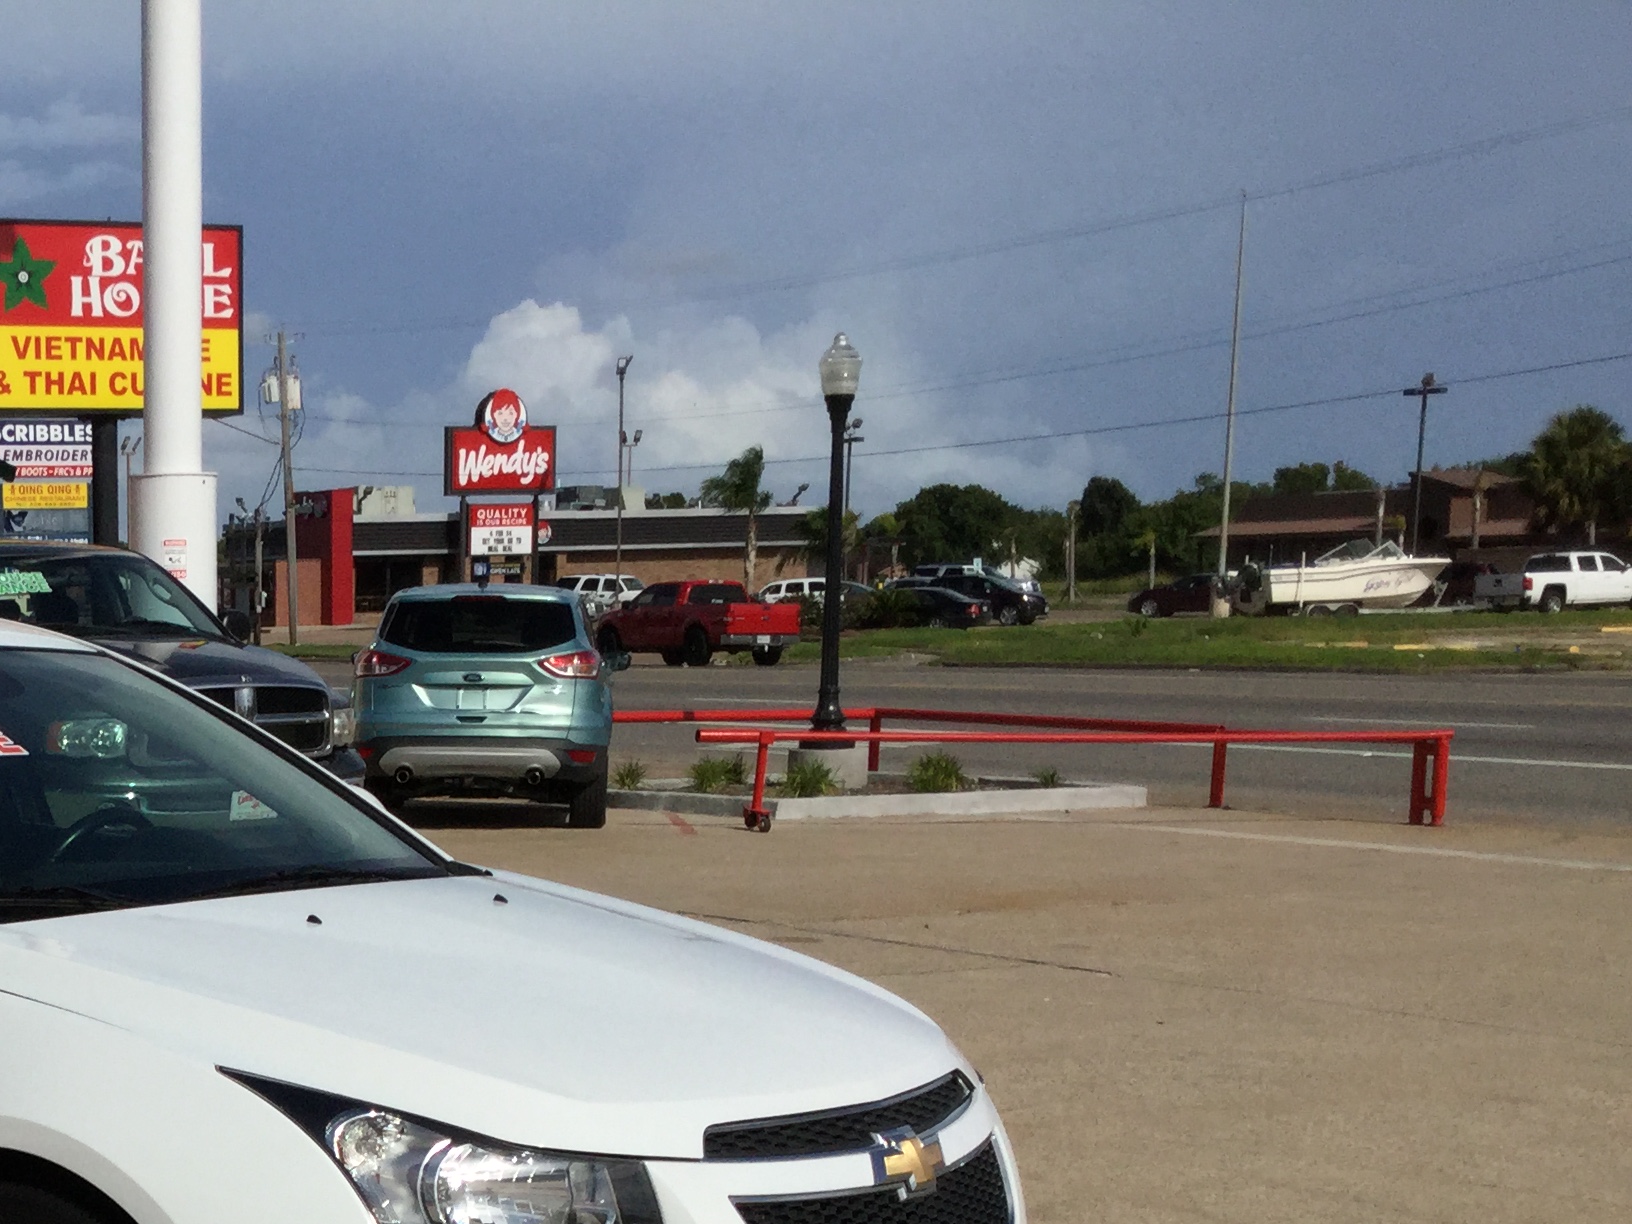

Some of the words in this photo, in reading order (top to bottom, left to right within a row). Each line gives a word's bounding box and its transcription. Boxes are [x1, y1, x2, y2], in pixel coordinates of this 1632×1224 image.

[83, 234, 232, 277] BAL
[71, 275, 234, 318] HOE
[23, 371, 96, 395] THAI
[109, 372, 233, 396] CUNE
[3, 449, 92, 461] EMBROIDER
[459, 439, 549, 486] Wendy's
[21, 467, 48, 477] BOOTS
[75, 467, 82, 476] &
[18, 485, 44, 495] QING
[47, 485, 72, 495] QING
[477, 508, 528, 519] QUALITY
[501, 518, 527, 526] RECIPE
